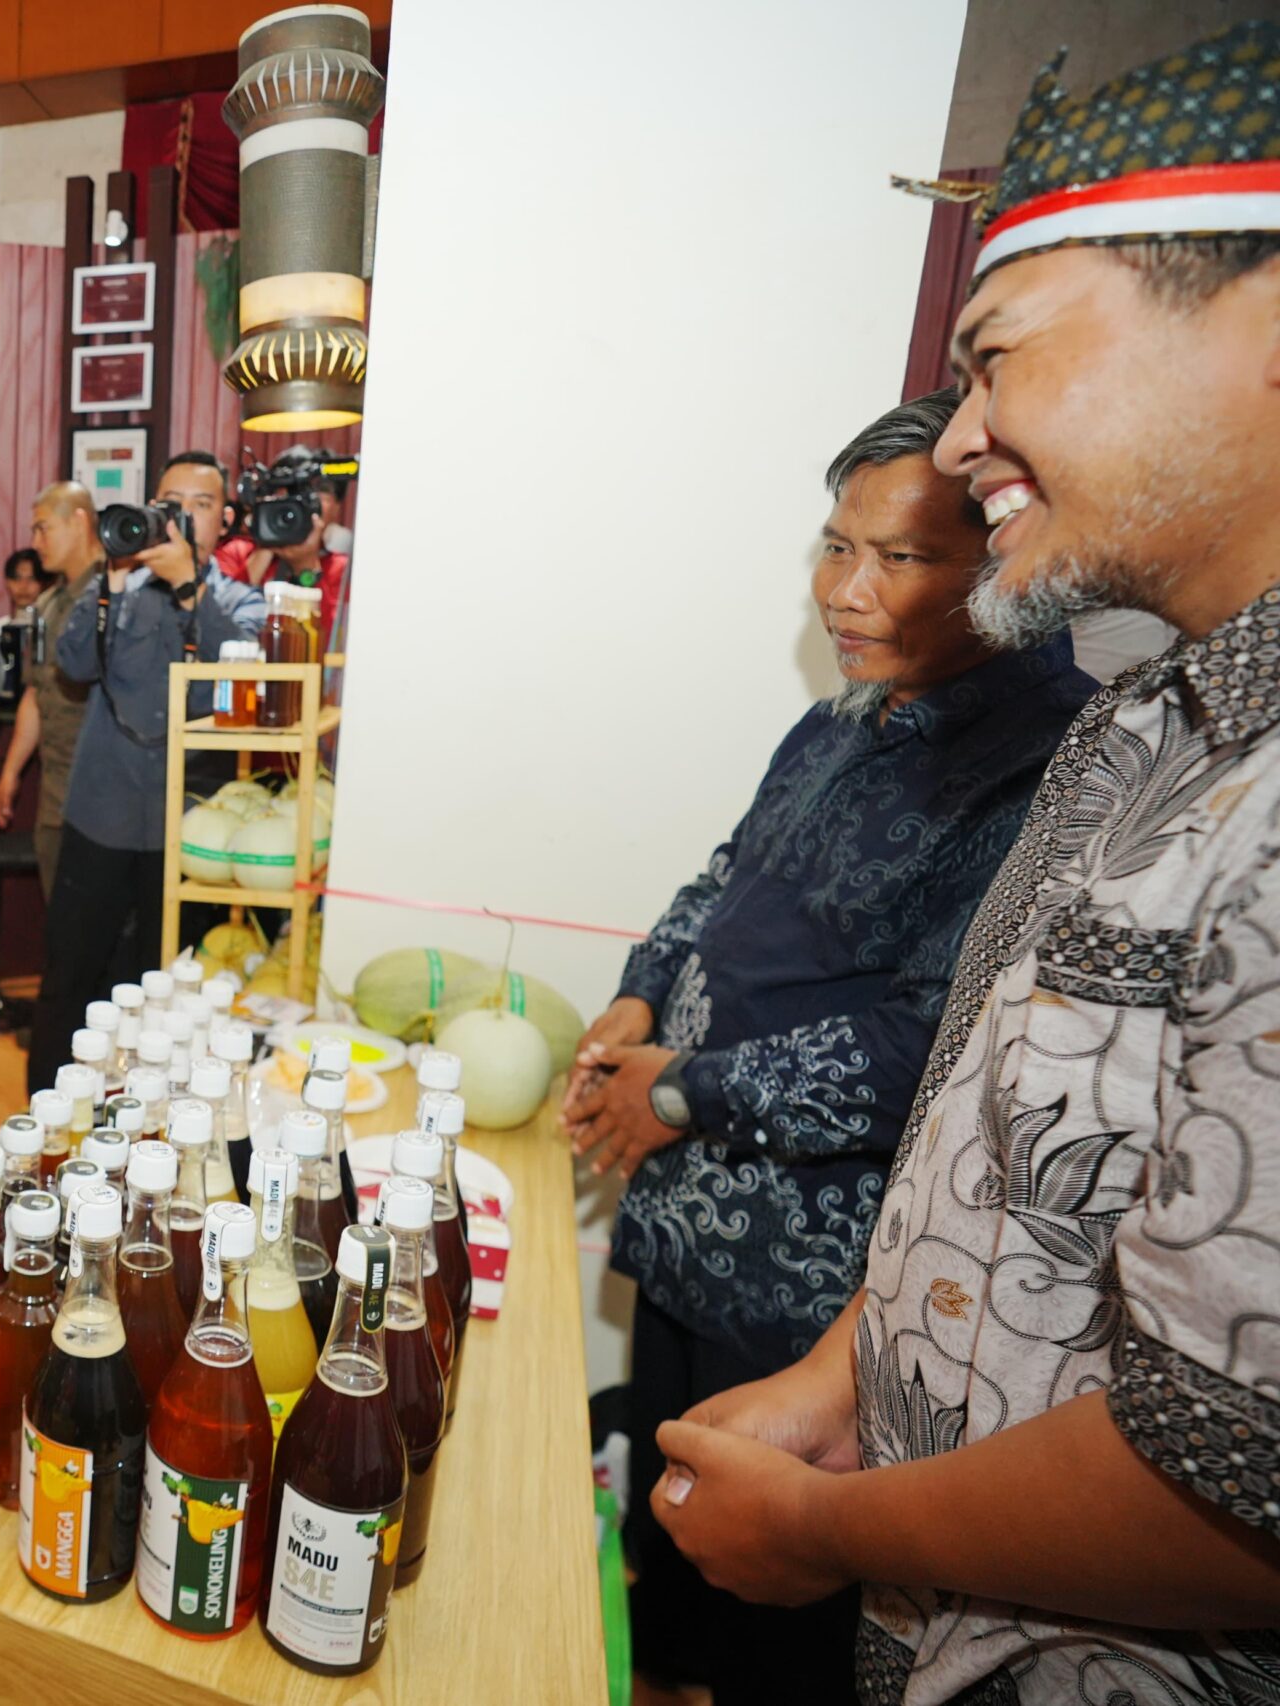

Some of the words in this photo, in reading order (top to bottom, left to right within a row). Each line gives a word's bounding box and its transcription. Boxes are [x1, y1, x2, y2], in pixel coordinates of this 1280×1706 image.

[55, 1511, 75, 1580] MANGGA
[203, 1528, 229, 1619] SONOKELING
[287, 1536, 339, 1572] MADU
[283, 1555, 337, 1602] S4E
